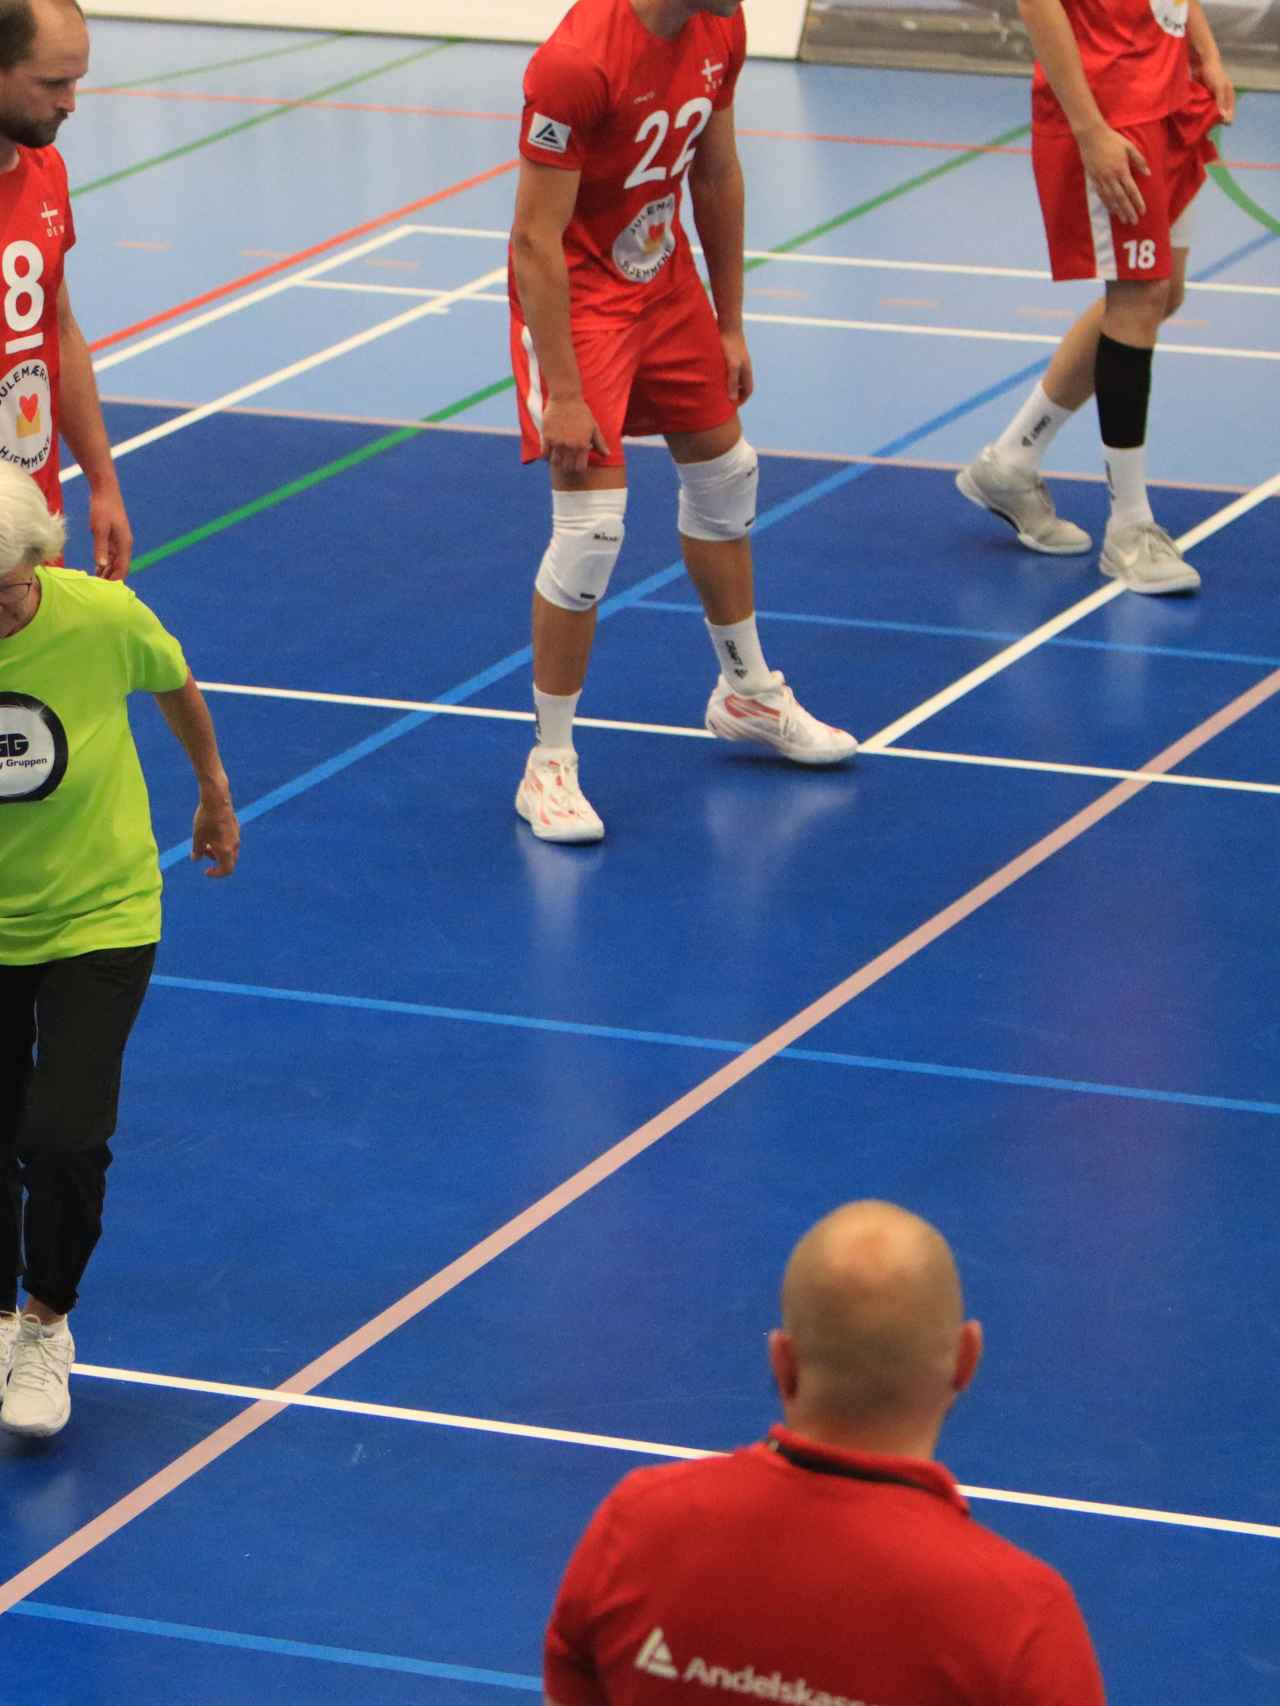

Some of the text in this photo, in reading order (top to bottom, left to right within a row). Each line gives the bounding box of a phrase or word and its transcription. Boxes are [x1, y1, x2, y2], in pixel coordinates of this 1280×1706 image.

[624, 97, 712, 189] 22
[1122, 240, 1156, 270] 18
[2, 240, 45, 332] 8
[6, 758, 47, 768] Gruppen
